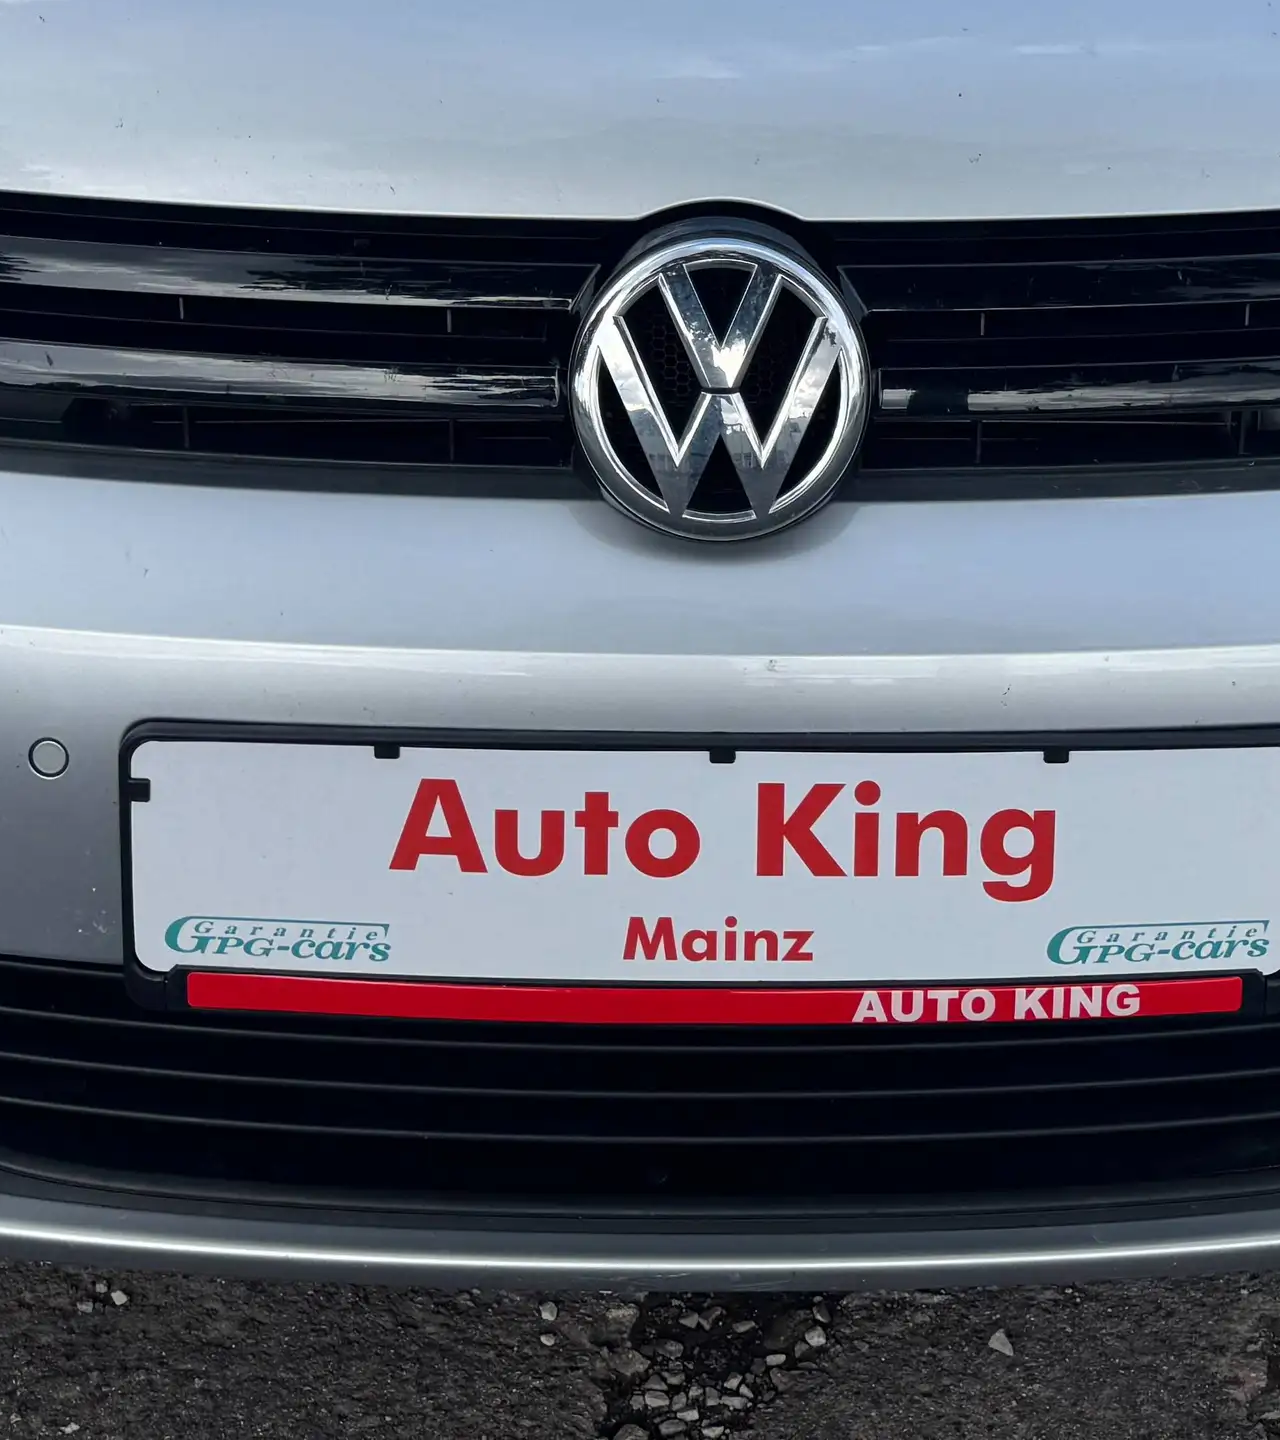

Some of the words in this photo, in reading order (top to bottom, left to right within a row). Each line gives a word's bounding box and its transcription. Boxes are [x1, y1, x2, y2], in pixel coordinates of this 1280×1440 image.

[388, 777, 702, 879] Auto
[755, 779, 1057, 903] King
[164, 916, 391, 962] GPG-cars
[194, 920, 378, 941] Garantie
[623, 916, 816, 962] Mainz
[1046, 920, 1270, 965] GPG-cars
[1076, 925, 1258, 944] Garantie
[852, 989, 996, 1023] AUTO
[1014, 984, 1141, 1020] KING
